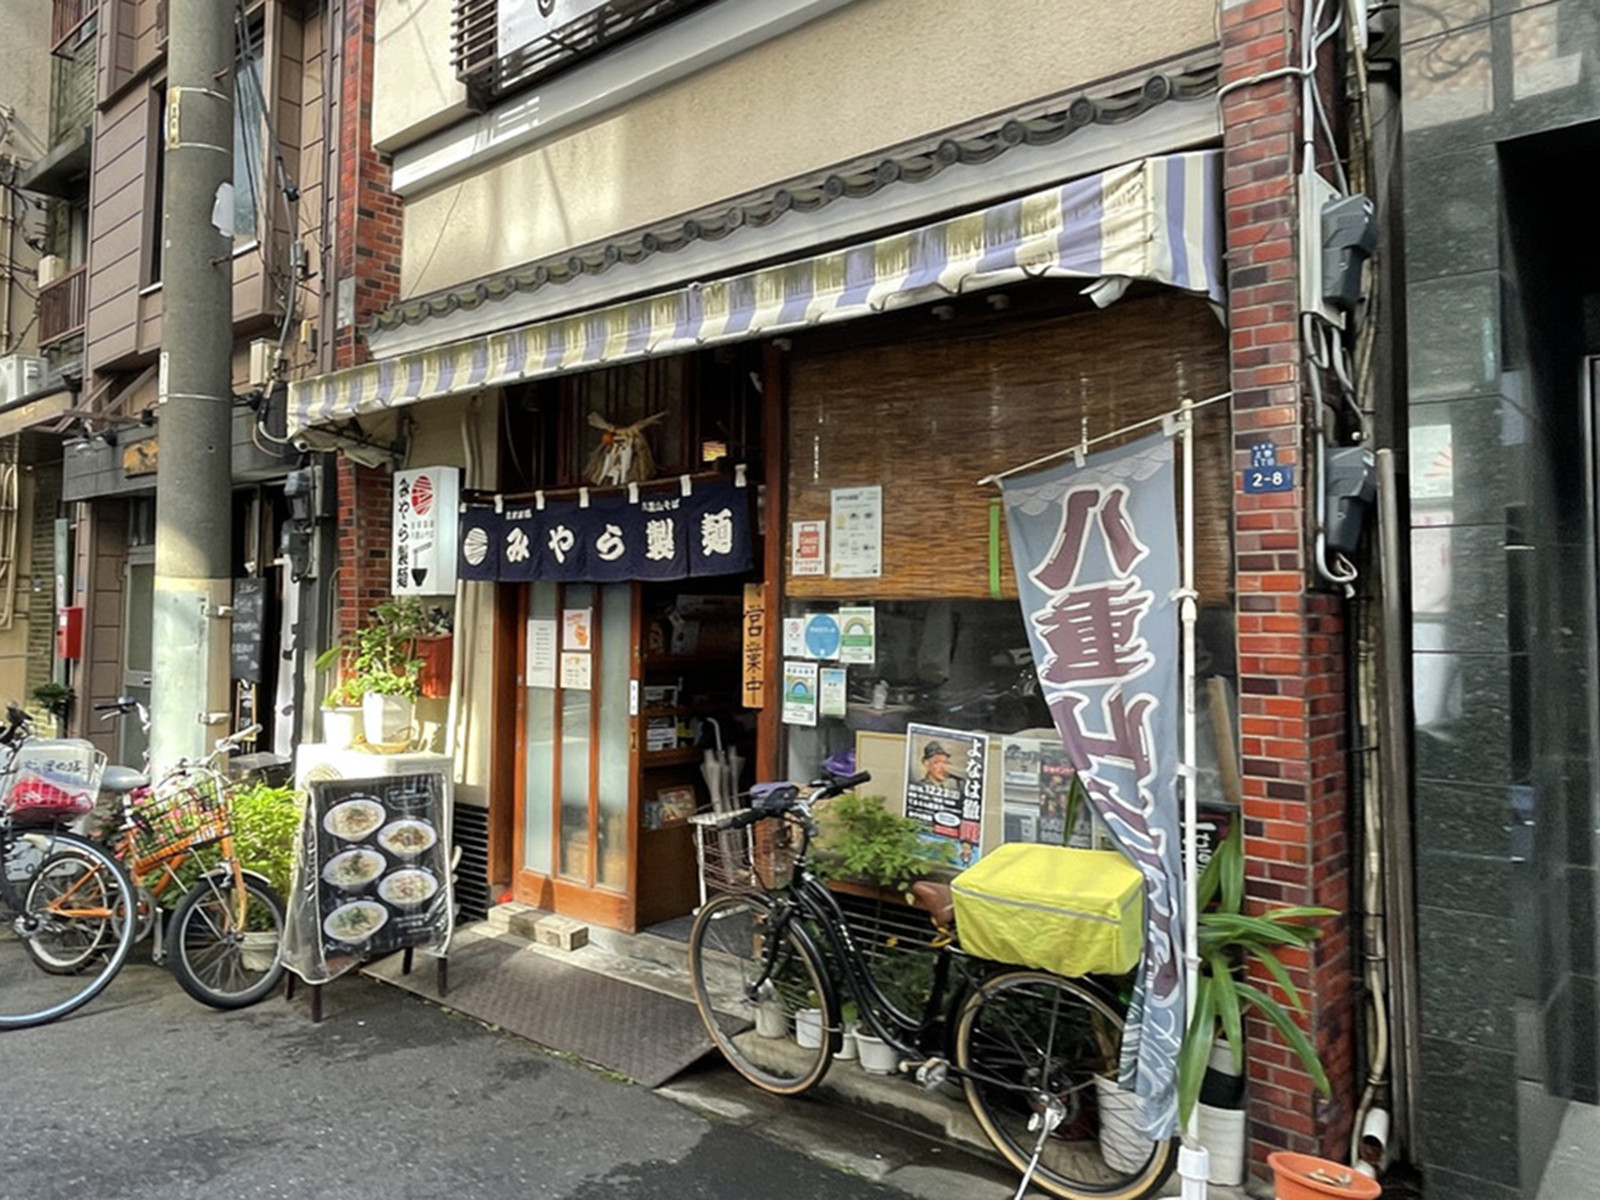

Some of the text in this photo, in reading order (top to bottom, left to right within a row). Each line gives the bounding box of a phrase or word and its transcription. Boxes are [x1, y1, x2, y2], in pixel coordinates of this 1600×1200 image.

[1252, 471, 1283, 487] 2-8
[505, 508, 734, 564] みやら製麺
[744, 604, 764, 705] 営業中
